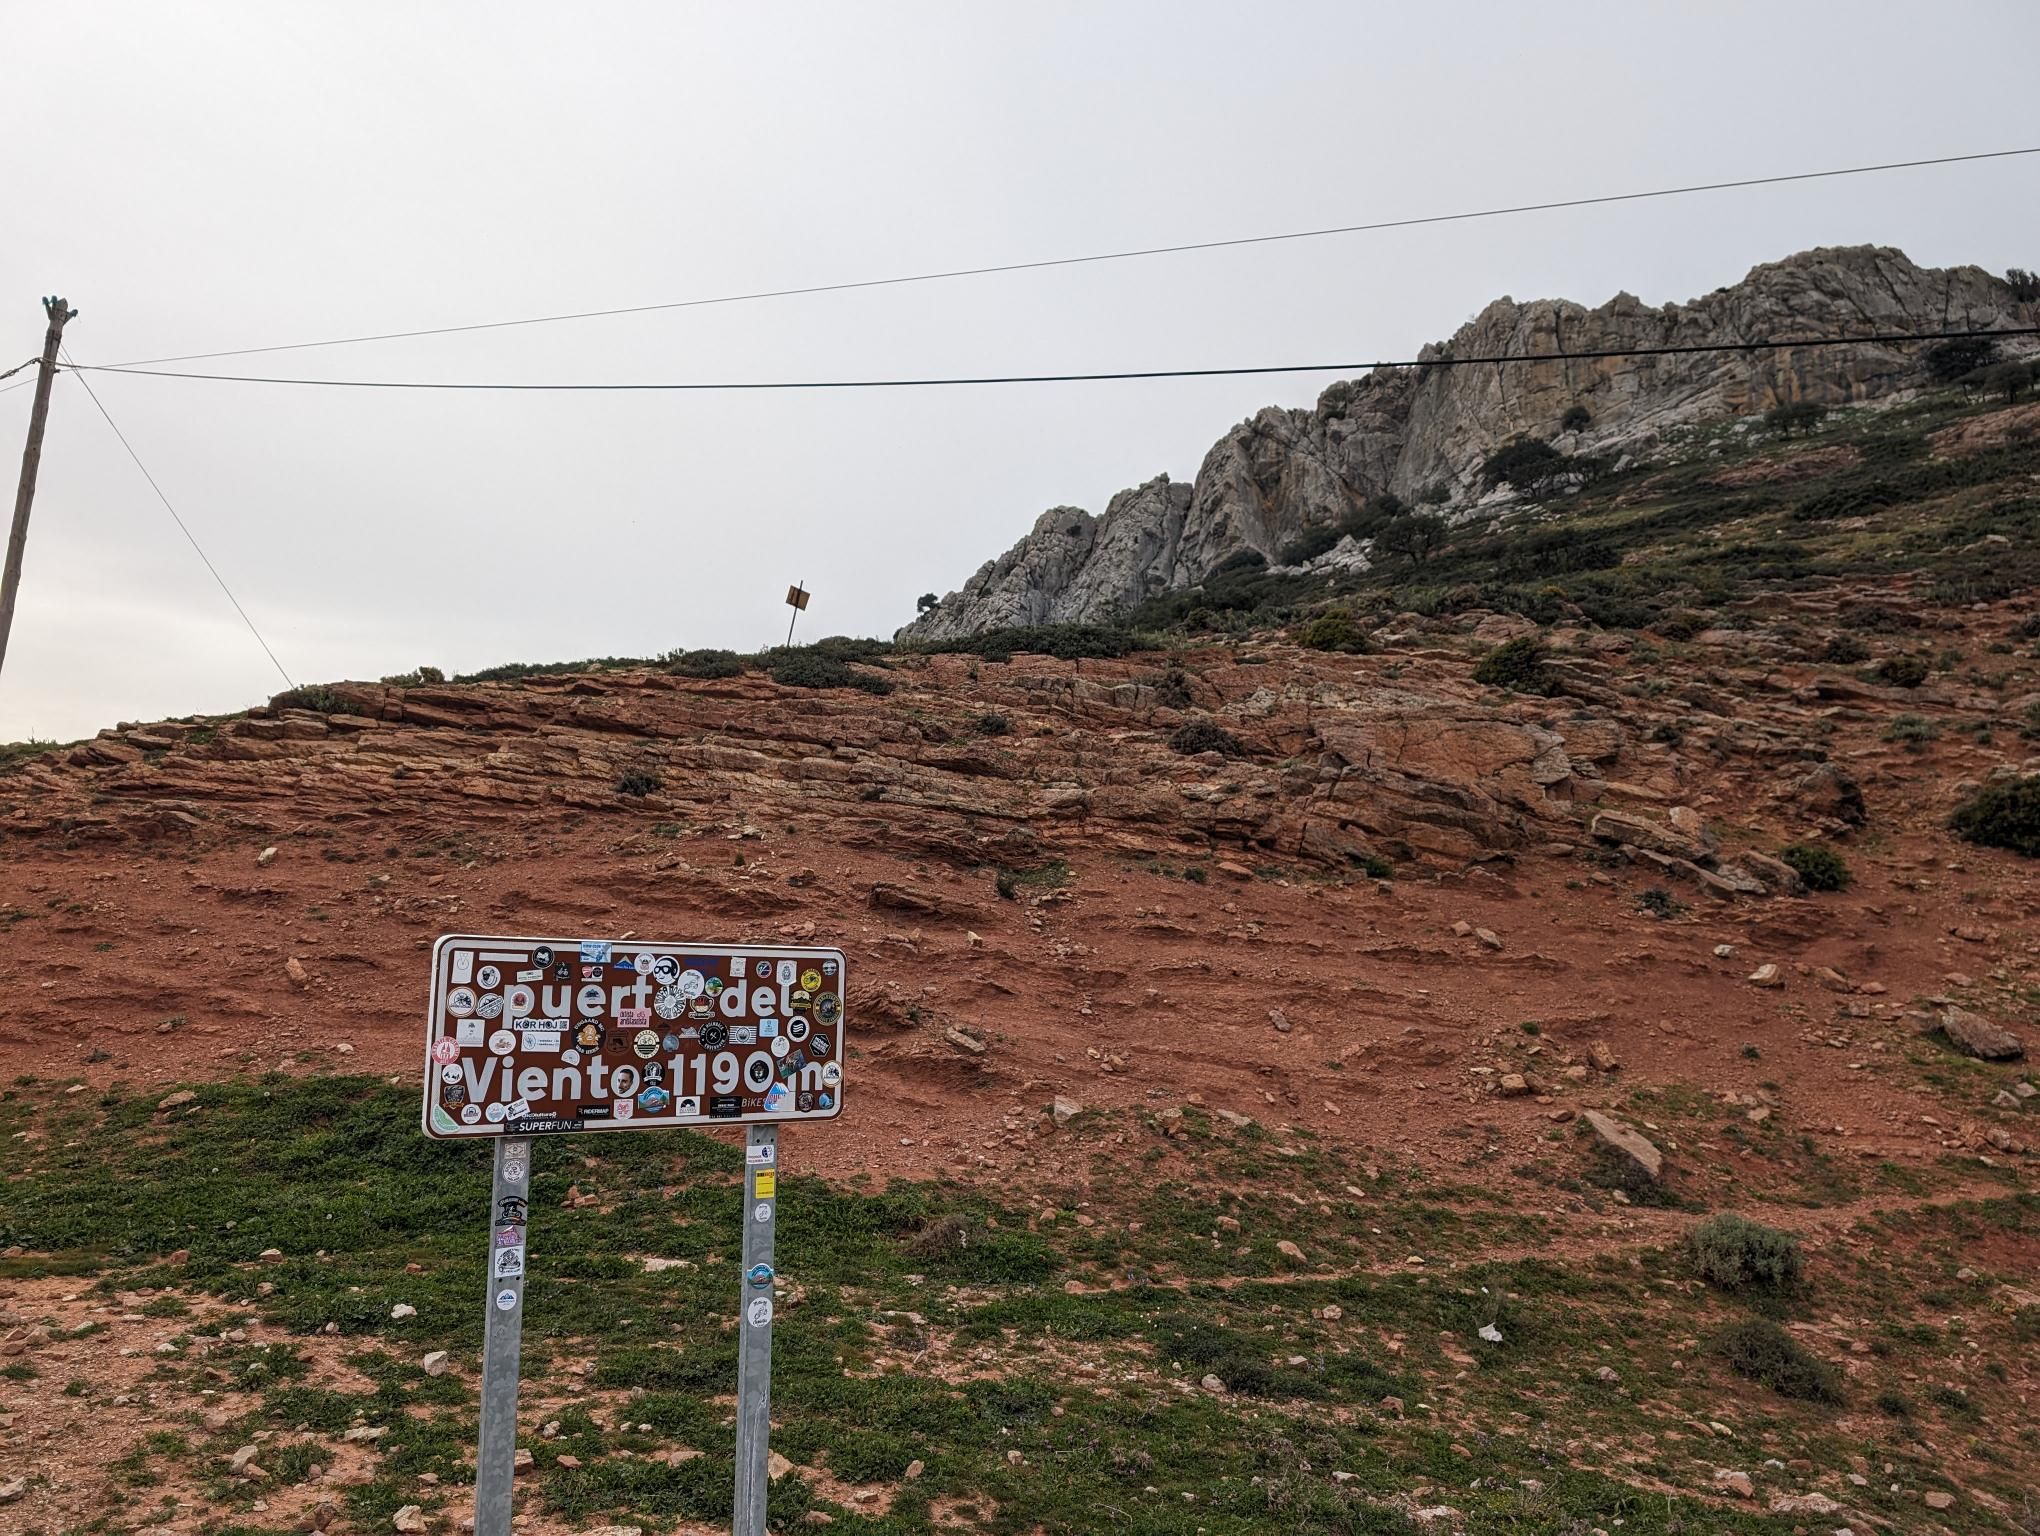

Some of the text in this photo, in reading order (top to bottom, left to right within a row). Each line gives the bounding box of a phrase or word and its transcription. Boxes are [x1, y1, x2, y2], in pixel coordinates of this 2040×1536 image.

[502, 976, 686, 1029] puert
[719, 979, 794, 1017] del
[462, 1051, 823, 1103] Viento 1190 m
[518, 1121, 572, 1132] SUPERFUN
